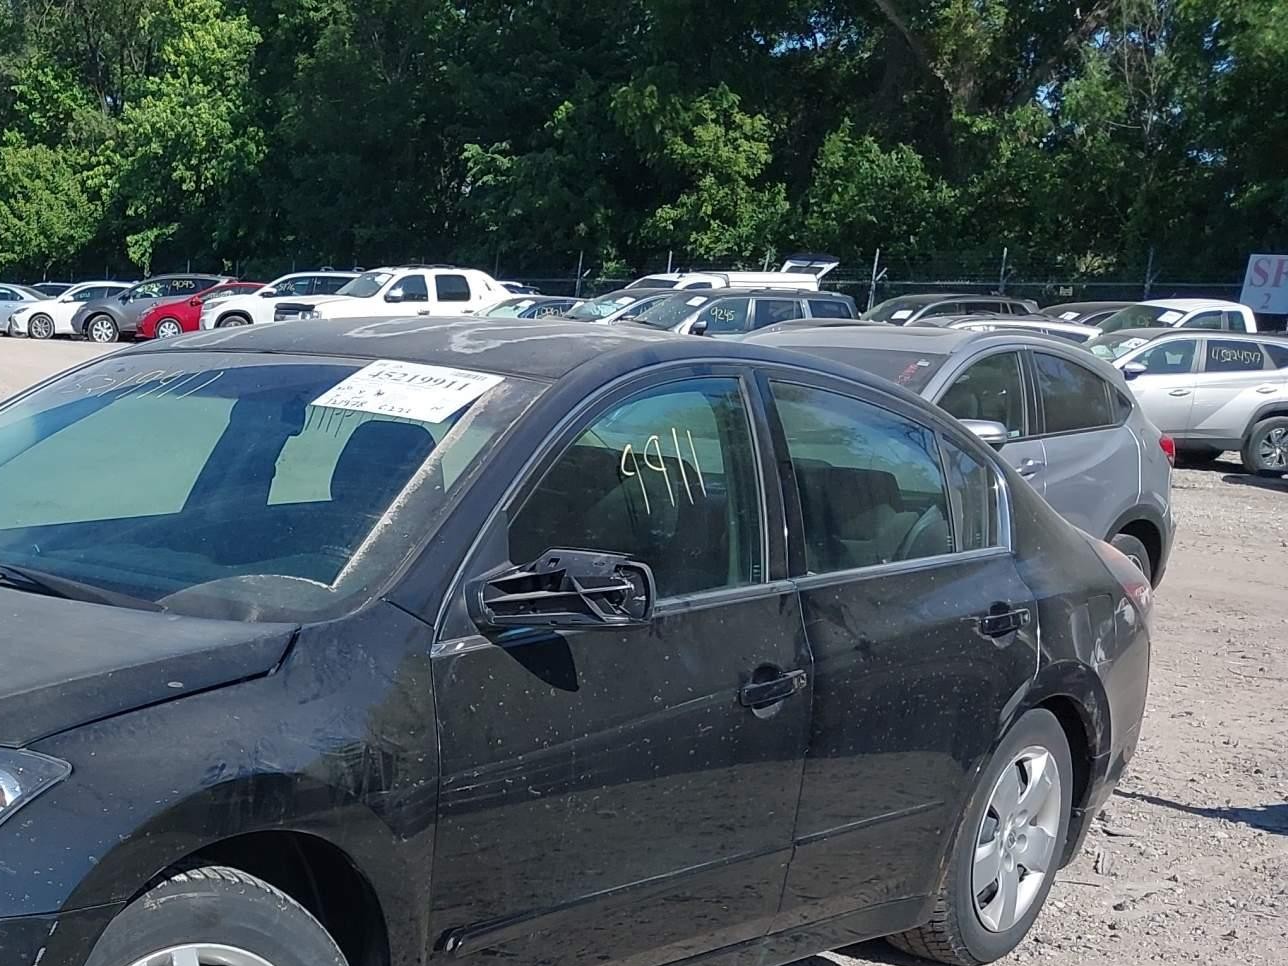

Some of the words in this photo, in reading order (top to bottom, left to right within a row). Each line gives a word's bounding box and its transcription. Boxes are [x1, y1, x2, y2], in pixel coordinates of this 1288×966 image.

[710, 306, 736, 323] 9245
[368, 368, 472, 392] 45219911
[620, 426, 708, 516] 9911
